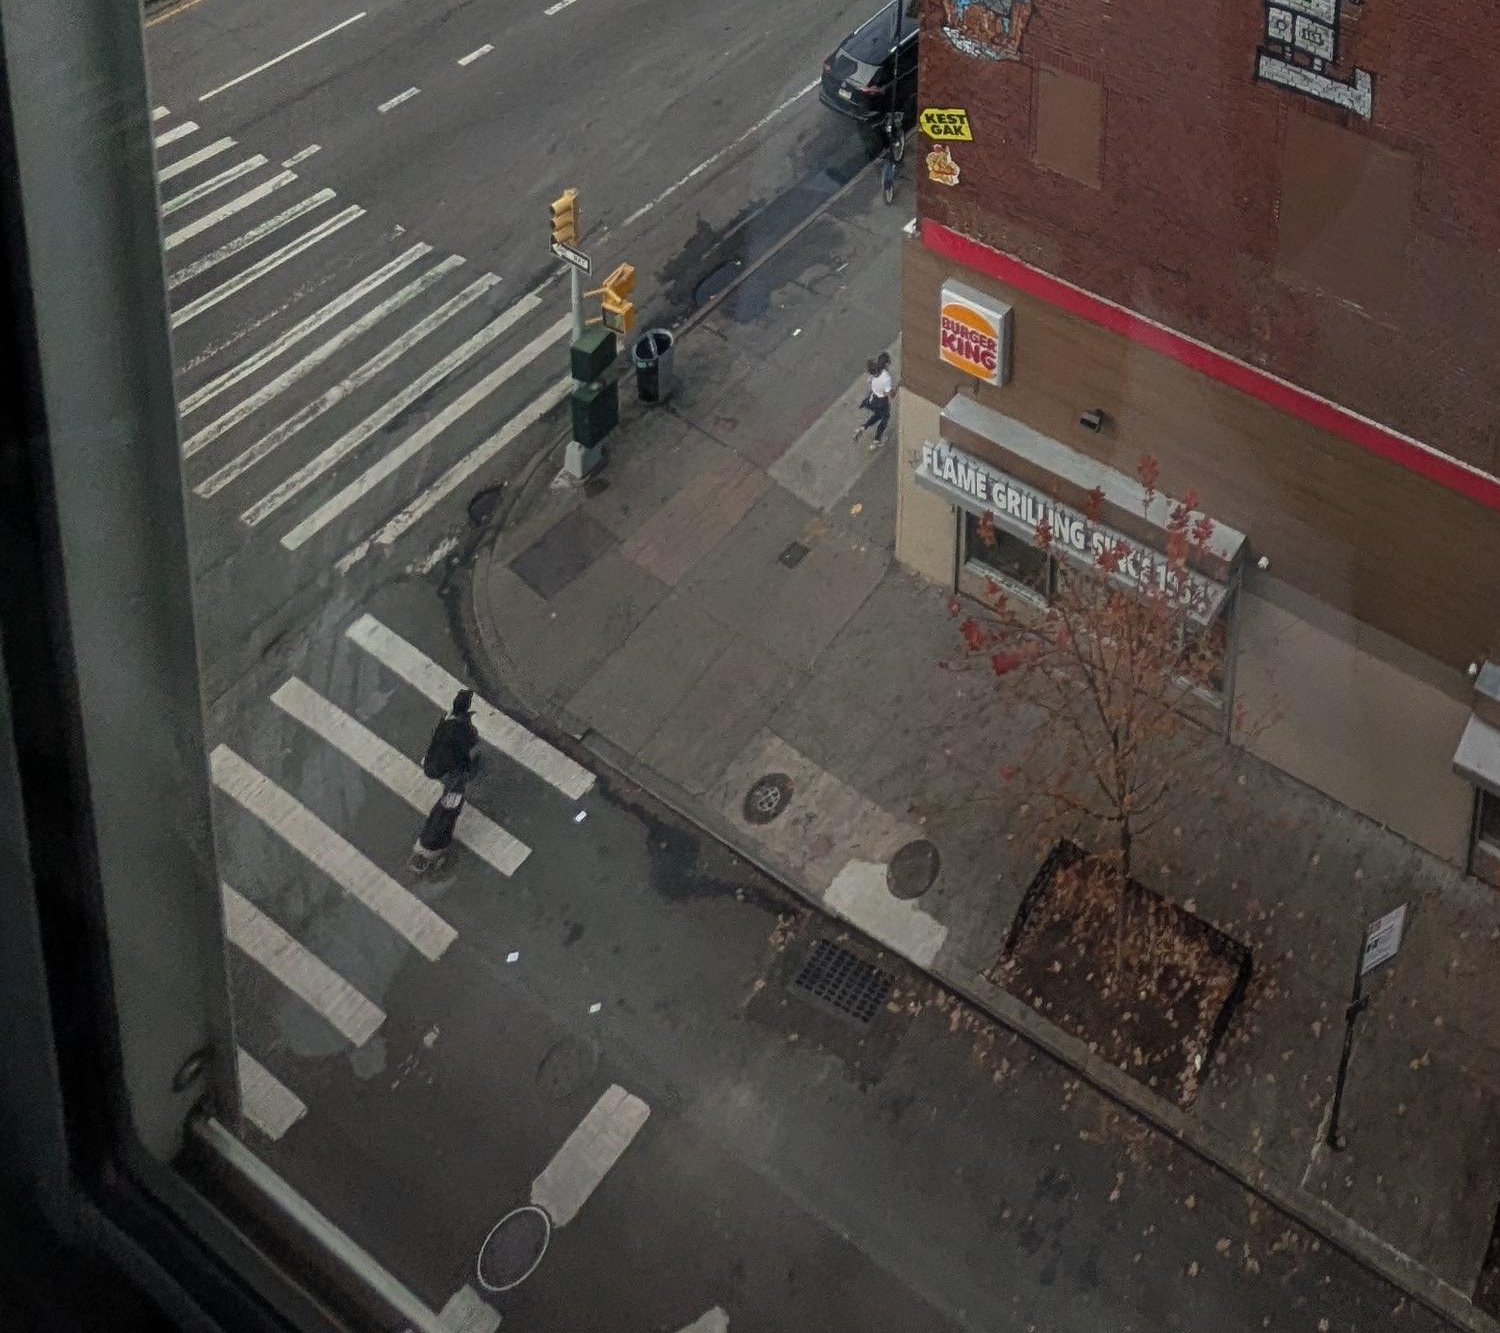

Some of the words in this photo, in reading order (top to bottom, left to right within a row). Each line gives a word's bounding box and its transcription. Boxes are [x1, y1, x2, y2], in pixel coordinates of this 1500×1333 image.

[924, 113, 966, 124] KEST
[930, 125, 965, 135] GAK
[941, 316, 997, 353] BURGER
[941, 330, 997, 370] KING
[922, 444, 988, 500] FLAME
[992, 482, 1085, 551] GRILLING
